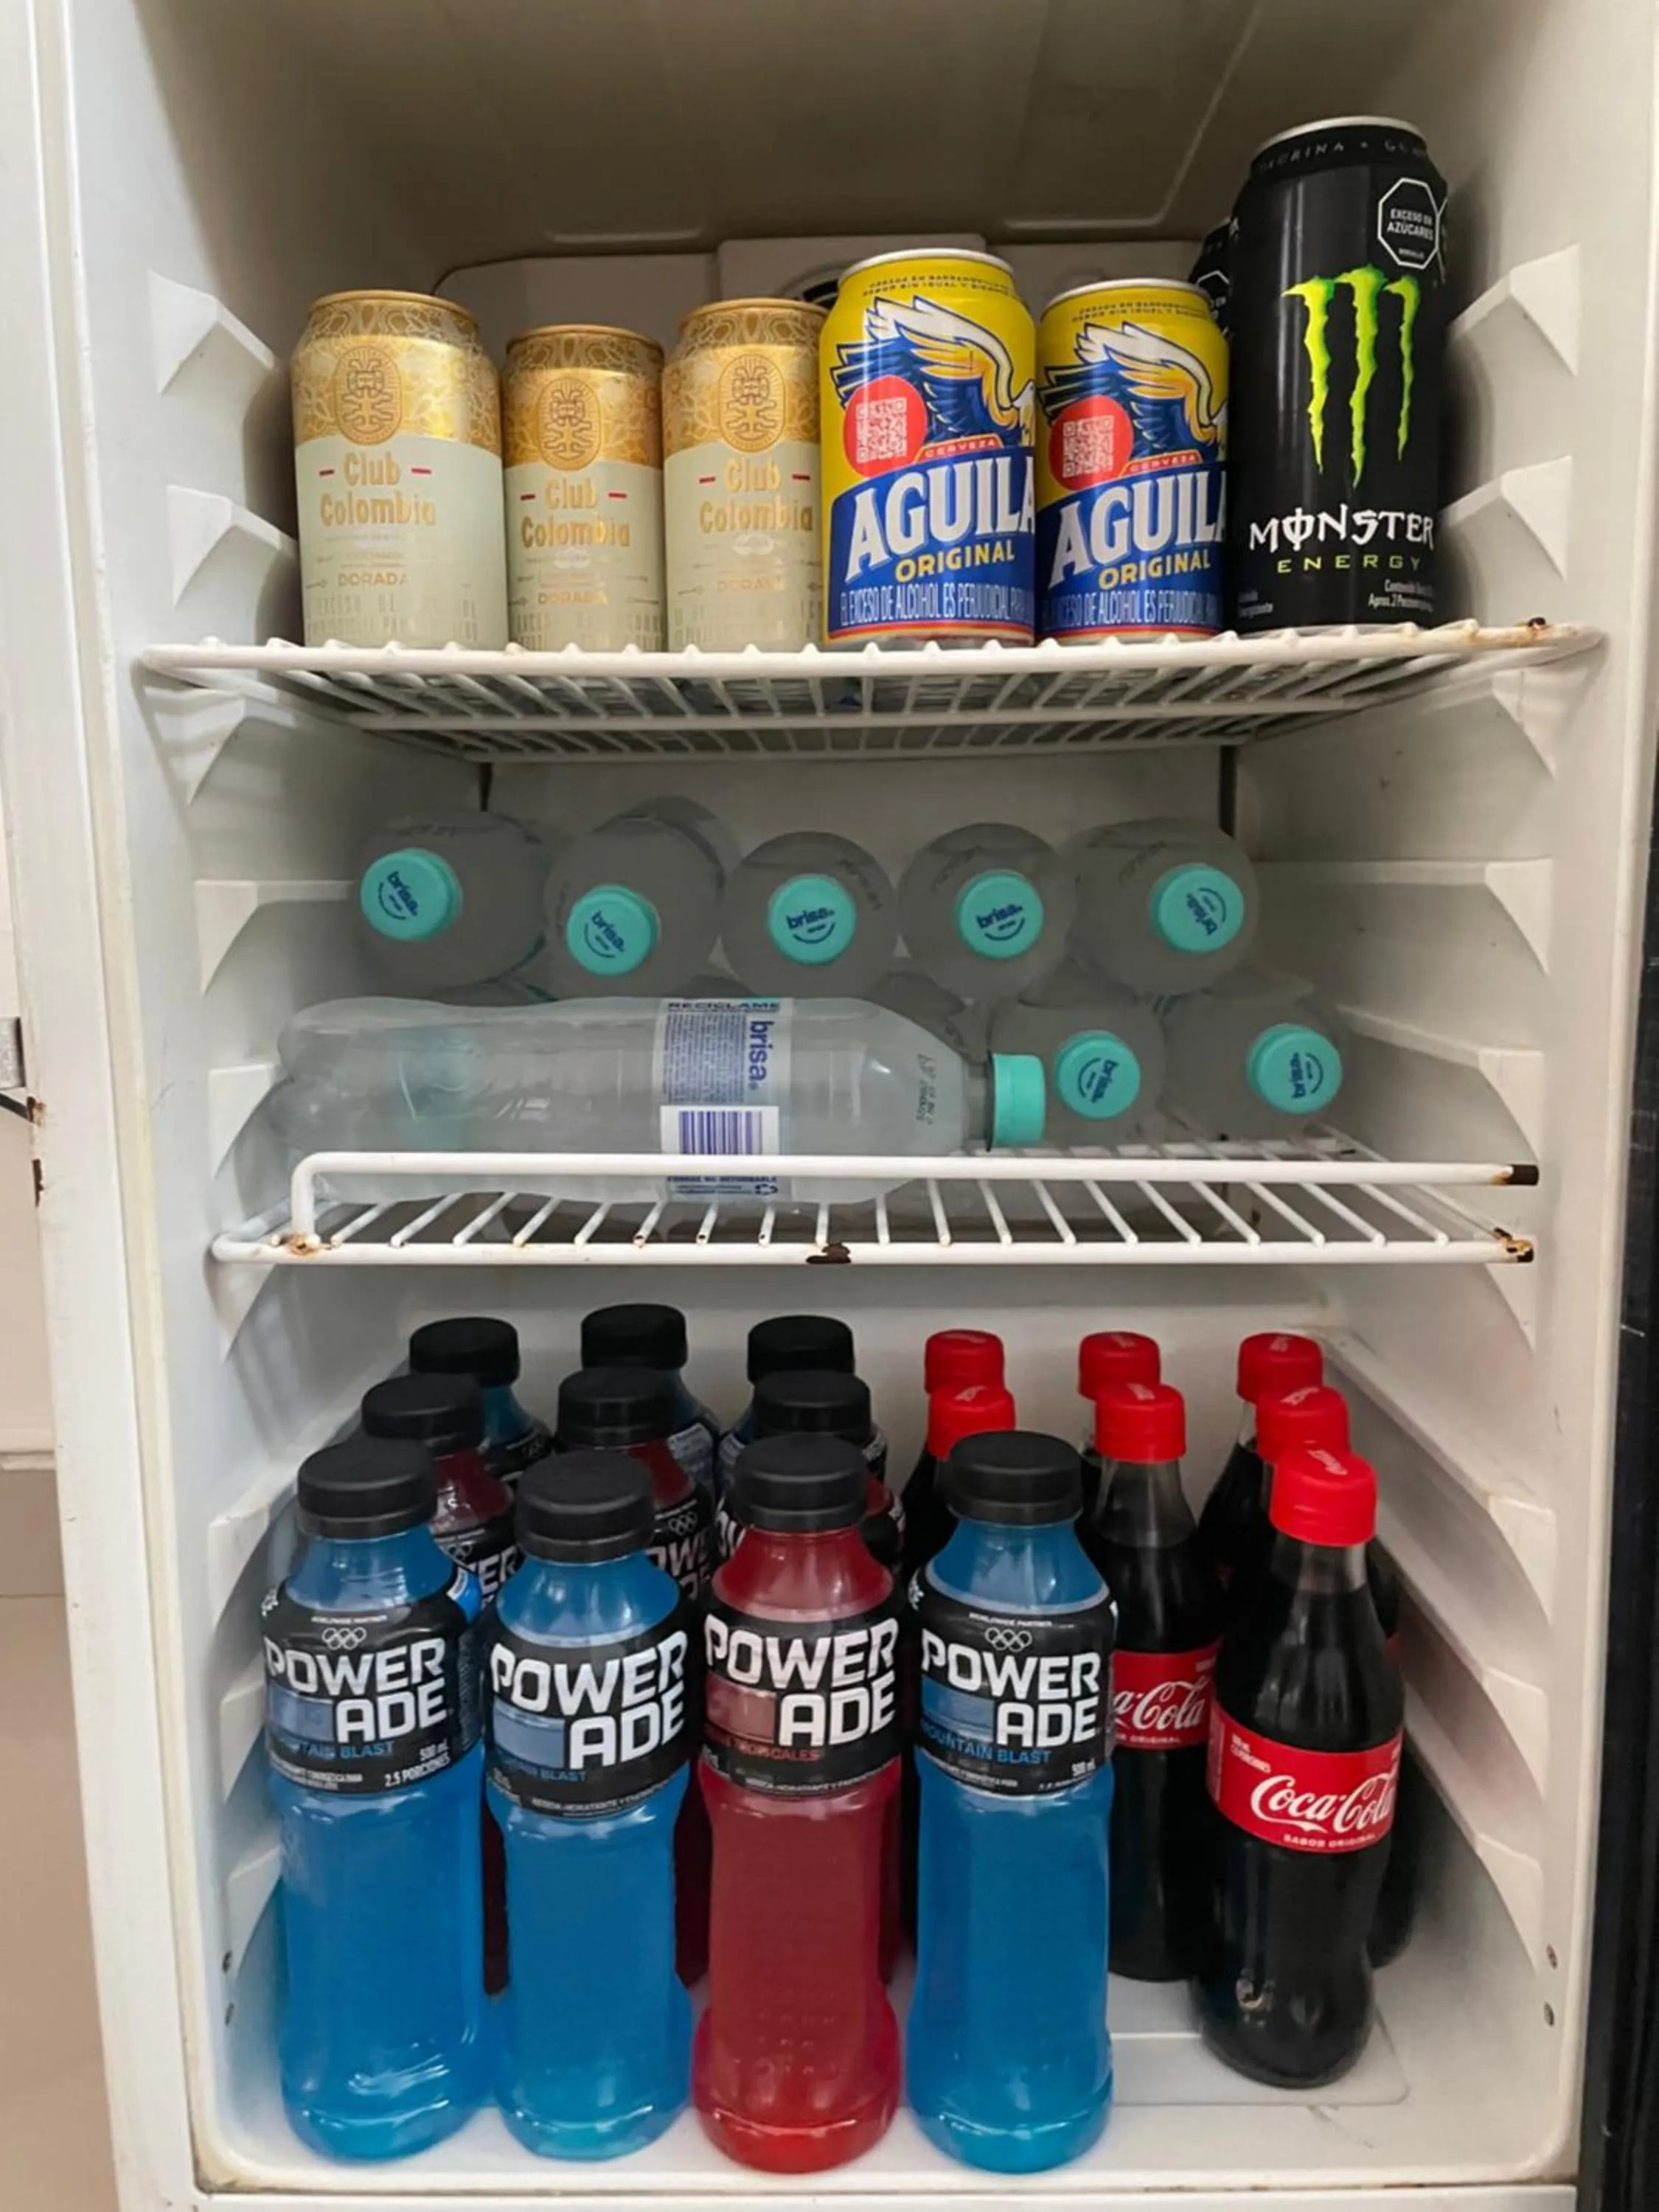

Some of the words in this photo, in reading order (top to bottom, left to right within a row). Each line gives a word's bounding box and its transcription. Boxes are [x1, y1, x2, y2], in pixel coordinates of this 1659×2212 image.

[925, 441, 995, 459] CERVEZA
[1130, 453, 1196, 473] CERVEZA
[344, 451, 401, 487] Club
[726, 458, 780, 493] Club
[319, 492, 437, 527] Colombia
[545, 478, 597, 510] Club
[521, 516, 630, 549] Colombia
[699, 501, 813, 534] Colombia
[1249, 504, 1434, 553] MONSTER
[338, 572, 411, 587] DORADA
[895, 540, 1015, 582] ORIGINAL
[1099, 549, 1211, 590] ORIGINAL
[1277, 554, 1421, 574] ENERGY
[881, 585, 894, 621] DE
[895, 582, 941, 619] ALCOHOL
[943, 582, 956, 618] ES
[1099, 589, 1142, 624] ALCOHOL
[1144, 589, 1156, 623] ES
[748, 1020, 776, 1087] brisa
[264, 1636, 445, 1696] POWER
[704, 1613, 899, 1690] POWER
[922, 1627, 1102, 1700] POWER
[490, 1630, 688, 1717] POWER
[336, 1677, 448, 1744] ADE
[779, 1670, 896, 1747] ADE
[1113, 1674, 1209, 1731] a-Cola
[569, 1679, 685, 1770] ADE
[997, 1696, 1099, 1747] ADE
[340, 1742, 396, 1759] BLAST
[996, 1750, 1053, 1765] BLAST
[1284, 1833, 1326, 1848] SABOR
